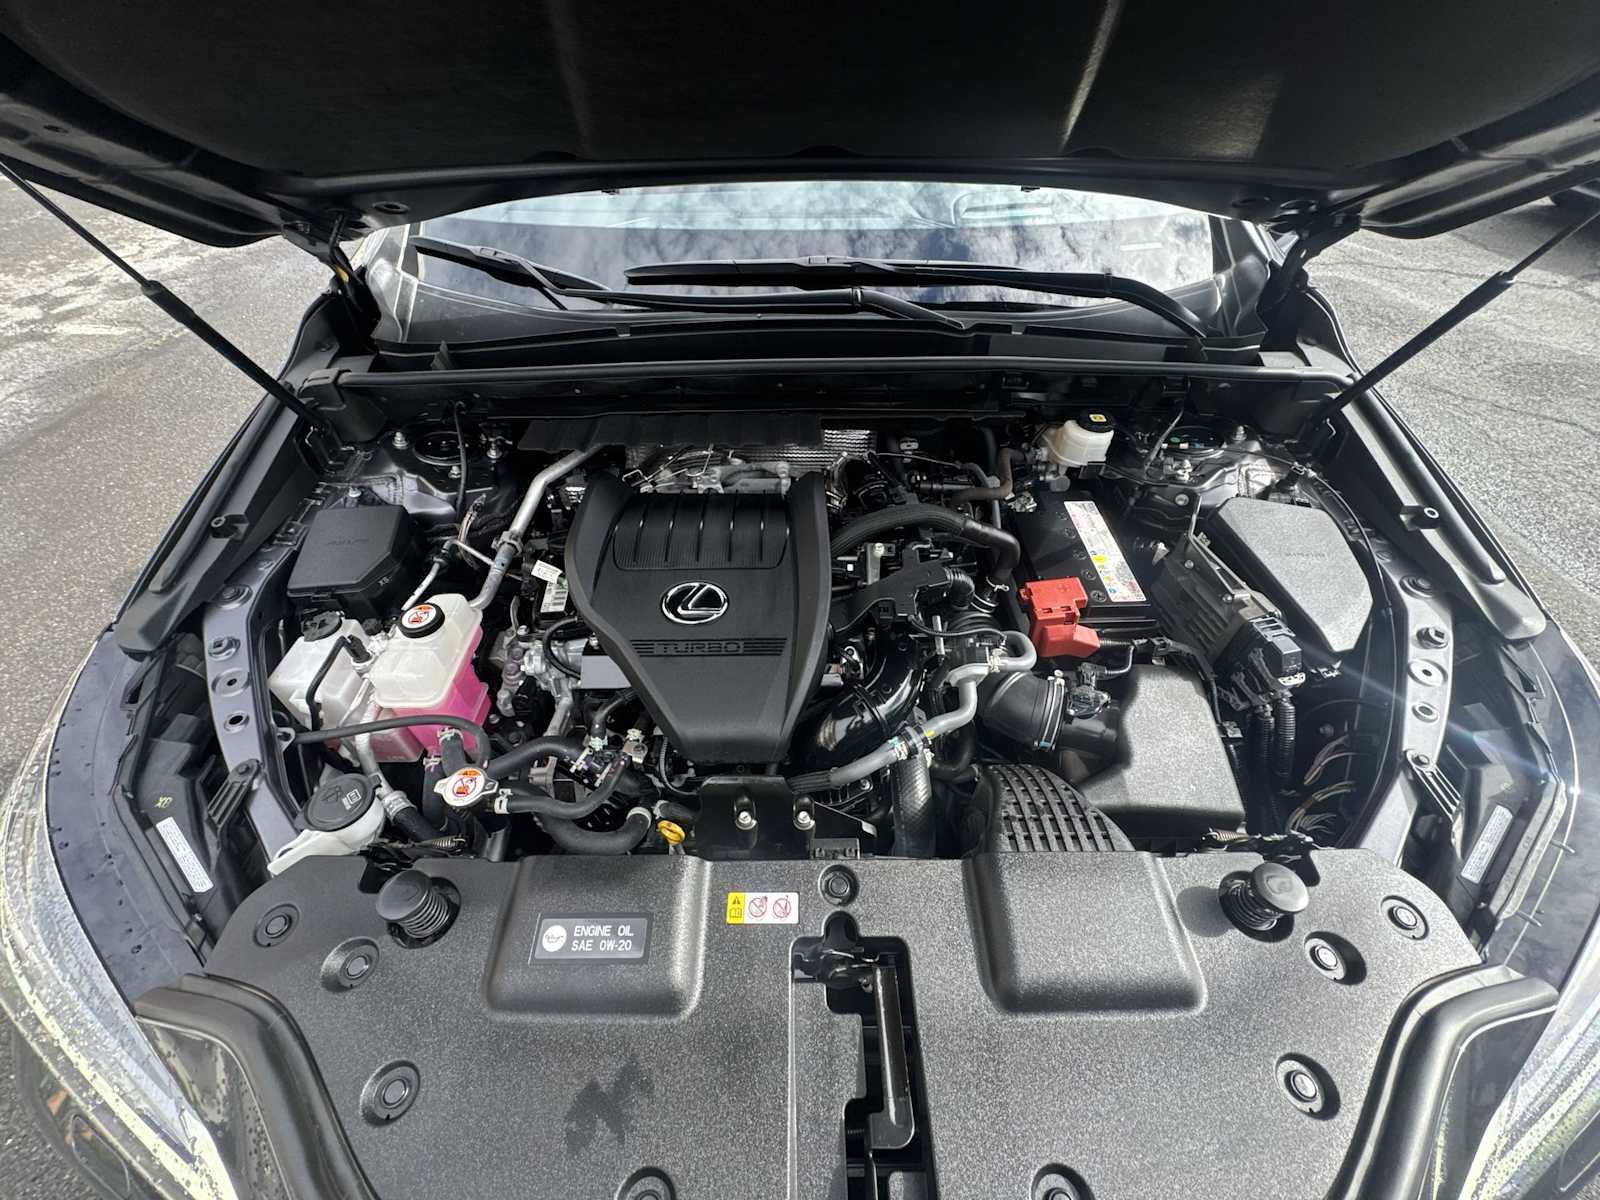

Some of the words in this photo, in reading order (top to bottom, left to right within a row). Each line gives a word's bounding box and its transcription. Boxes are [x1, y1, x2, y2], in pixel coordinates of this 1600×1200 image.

[655, 641, 742, 654] TURBO
[573, 925, 612, 937] ENGINE
[617, 925, 634, 937] OIL
[571, 939, 594, 951] SAE
[599, 939, 632, 951] 0W-20
